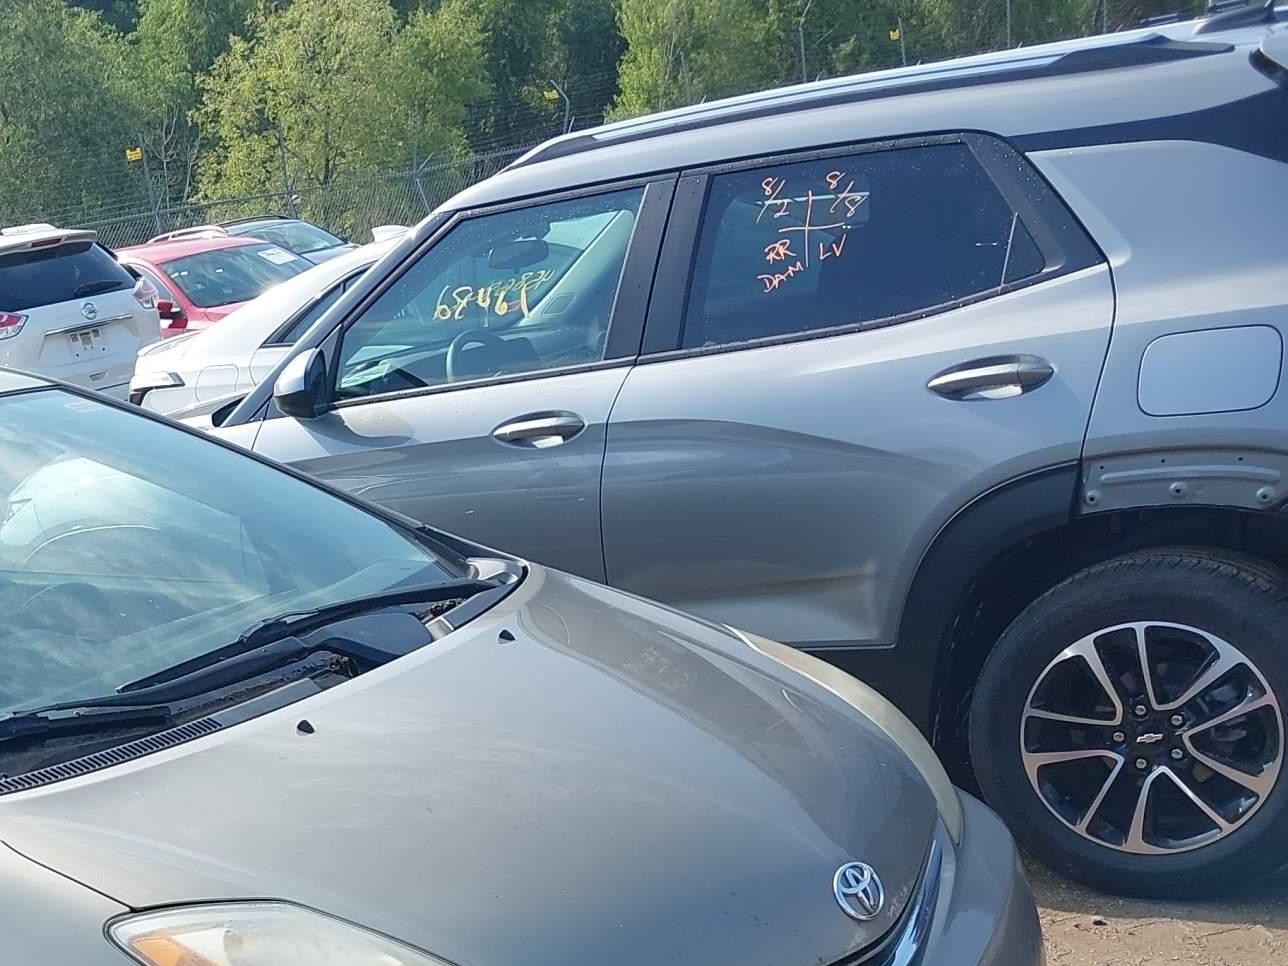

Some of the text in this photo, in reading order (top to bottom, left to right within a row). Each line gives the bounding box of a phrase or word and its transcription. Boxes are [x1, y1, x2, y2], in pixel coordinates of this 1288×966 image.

[825, 171, 868, 218] 8/8
[764, 239, 798, 264] RR
[819, 233, 847, 261] LV
[757, 261, 804, 293] DAM
